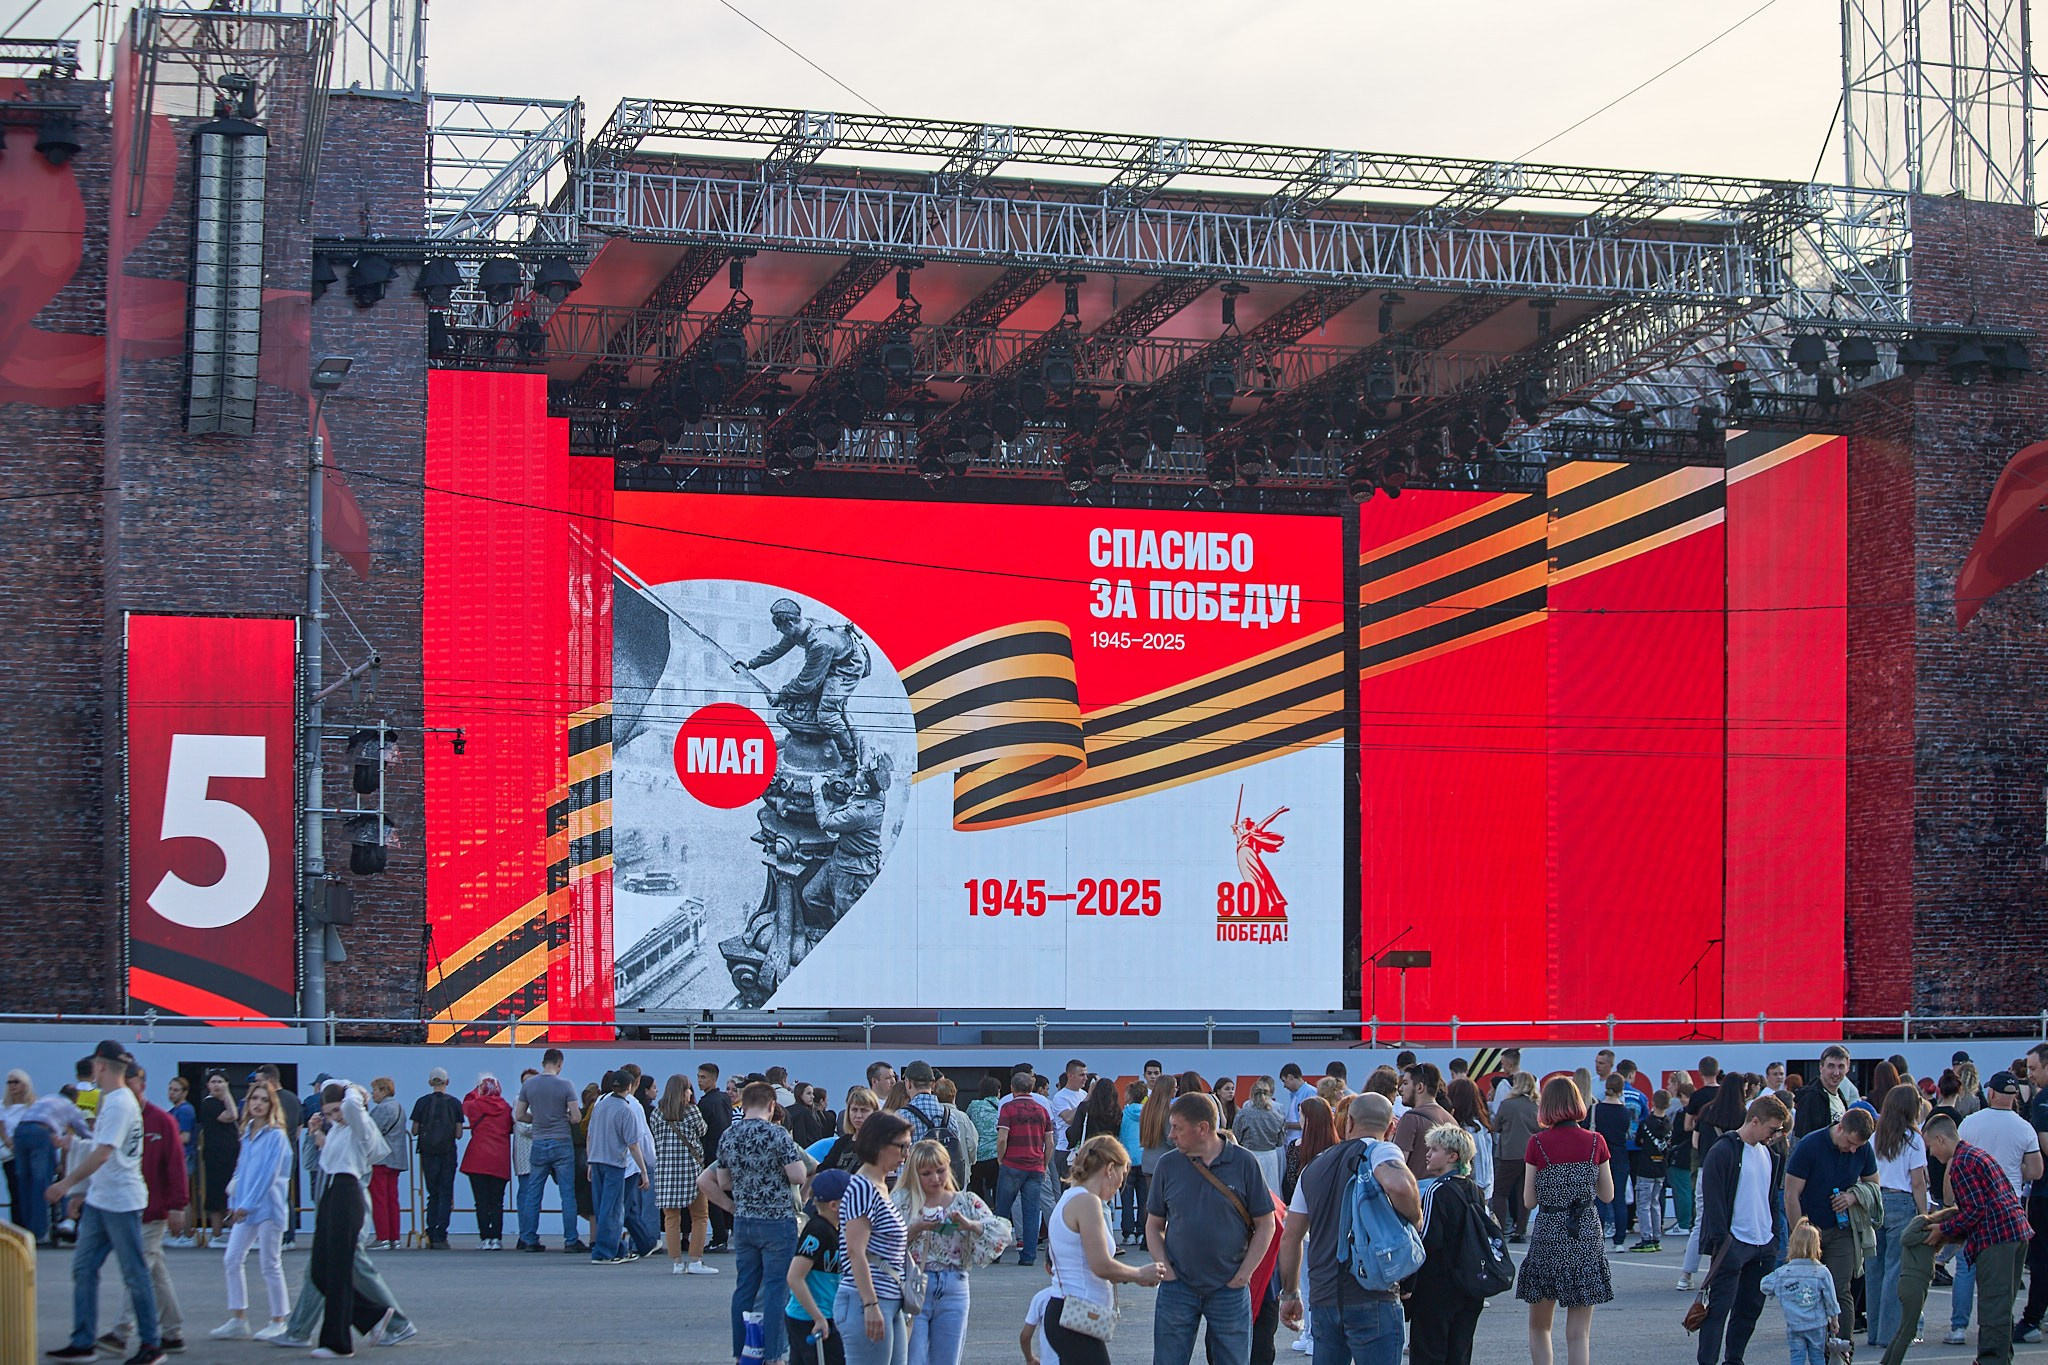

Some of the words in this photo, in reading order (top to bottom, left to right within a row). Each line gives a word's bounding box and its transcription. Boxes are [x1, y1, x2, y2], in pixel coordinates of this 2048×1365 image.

[1089, 527, 1253, 572] СПАСИБО
[1089, 578, 1137, 619] ЗА
[1150, 580, 1300, 629] ПОБЕДУ!
[687, 737, 764, 775] МАЯ
[147, 734, 270, 929] 5
[1217, 882, 1255, 917] 80
[1216, 923, 1288, 945] ПОБЕДА!
